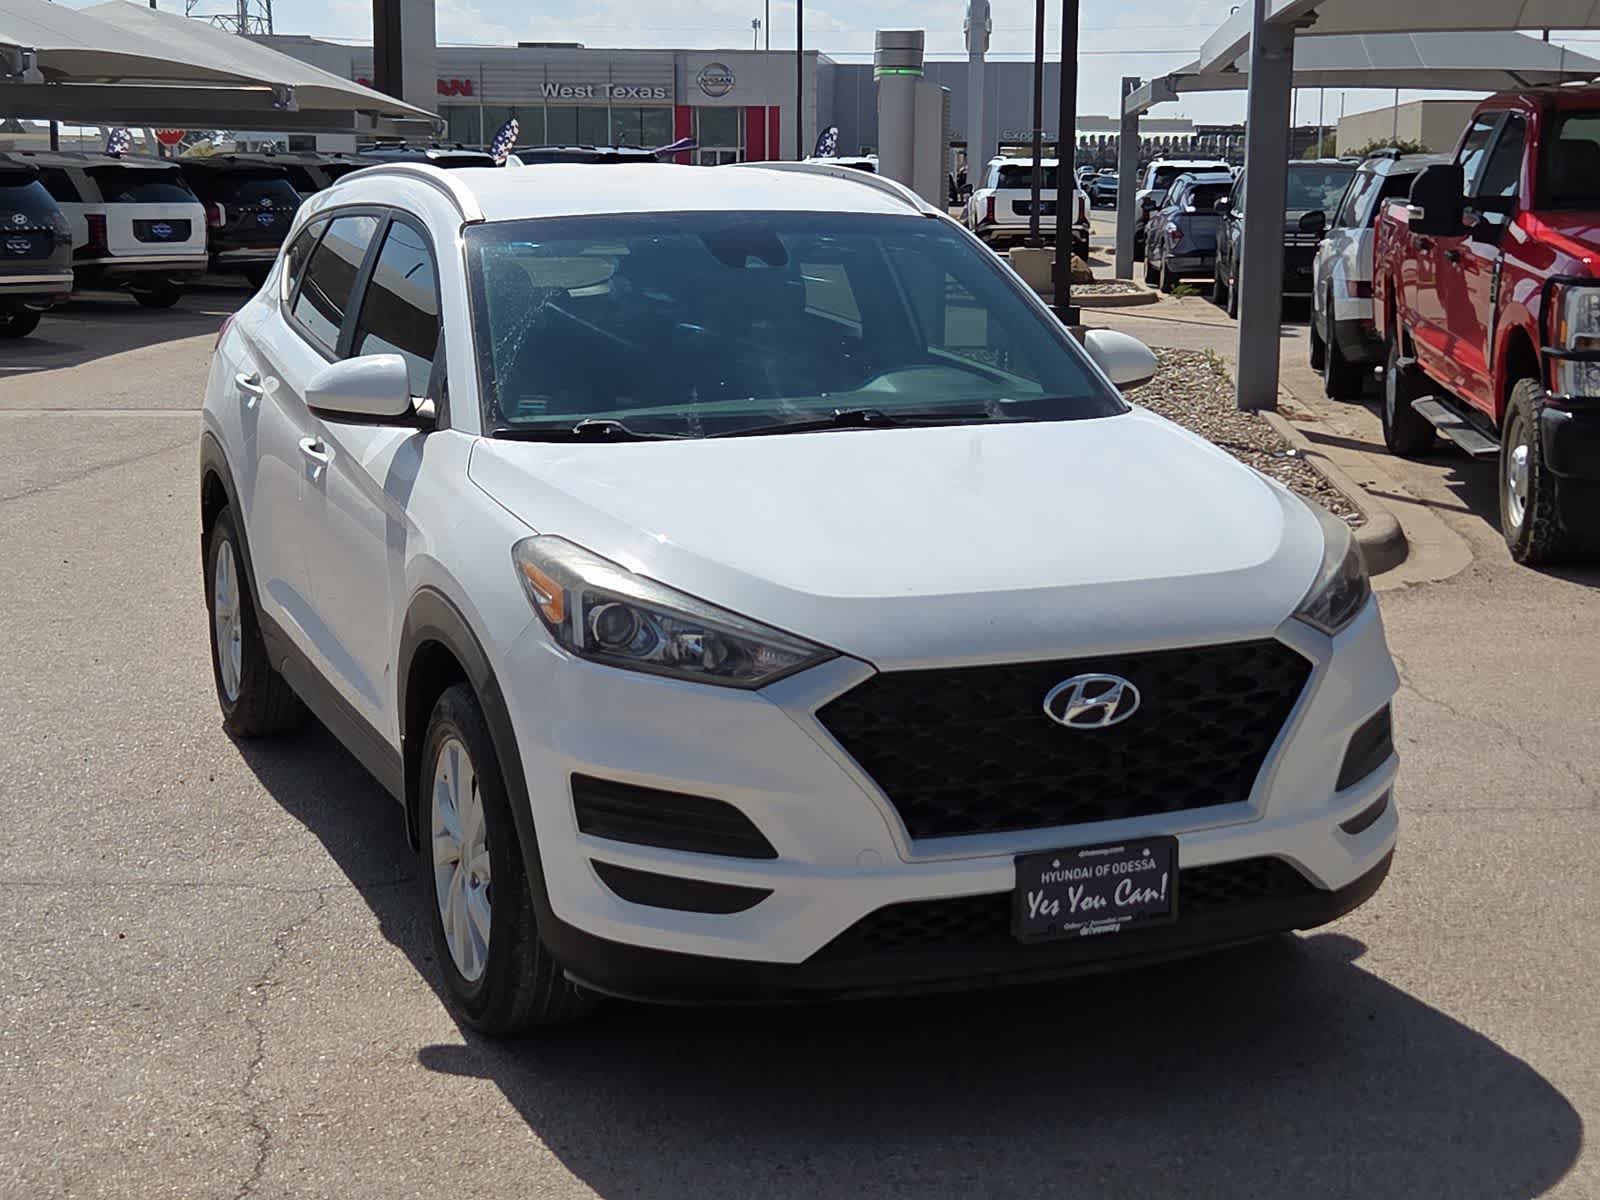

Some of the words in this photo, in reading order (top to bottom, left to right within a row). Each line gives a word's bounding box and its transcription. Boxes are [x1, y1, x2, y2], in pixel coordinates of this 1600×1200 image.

[540, 83, 593, 98] West
[601, 83, 666, 99] Texas
[1041, 867, 1092, 885] HYUNDAI
[1095, 864, 1111, 877] OF
[1112, 857, 1157, 874] ODESSA
[1027, 889, 1061, 920] Yes
[1068, 884, 1108, 913] You
[1114, 872, 1169, 907] Can!
